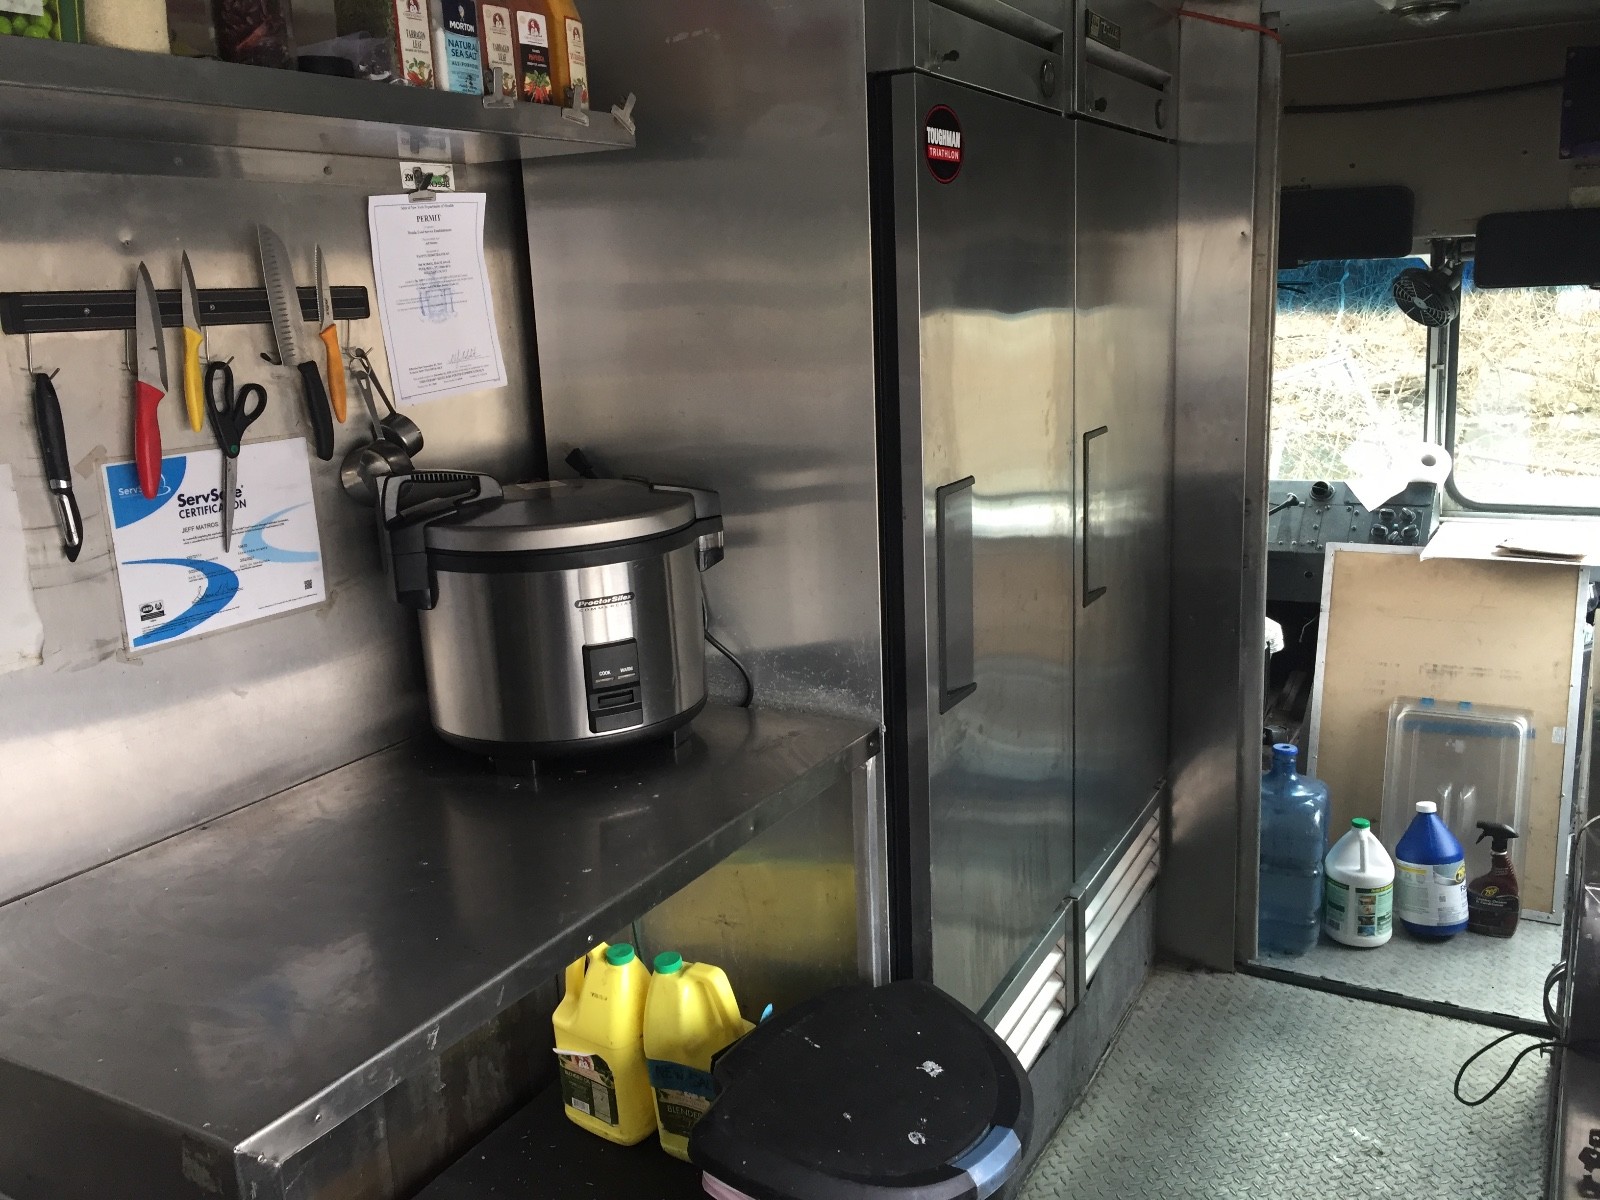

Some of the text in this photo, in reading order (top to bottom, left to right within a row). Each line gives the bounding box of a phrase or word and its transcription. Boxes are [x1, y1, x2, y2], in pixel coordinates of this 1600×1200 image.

[449, 20, 475, 33] MORTON
[448, 39, 479, 53] NATURAL
[451, 48, 478, 60] SEA SALT
[926, 126, 961, 149] TOUGHMAN
[929, 147, 959, 160] TRIATHLON
[416, 213, 441, 223] PERMIT
[178, 499, 247, 519] CERTIFICAON
[182, 524, 195, 534] JEFF
